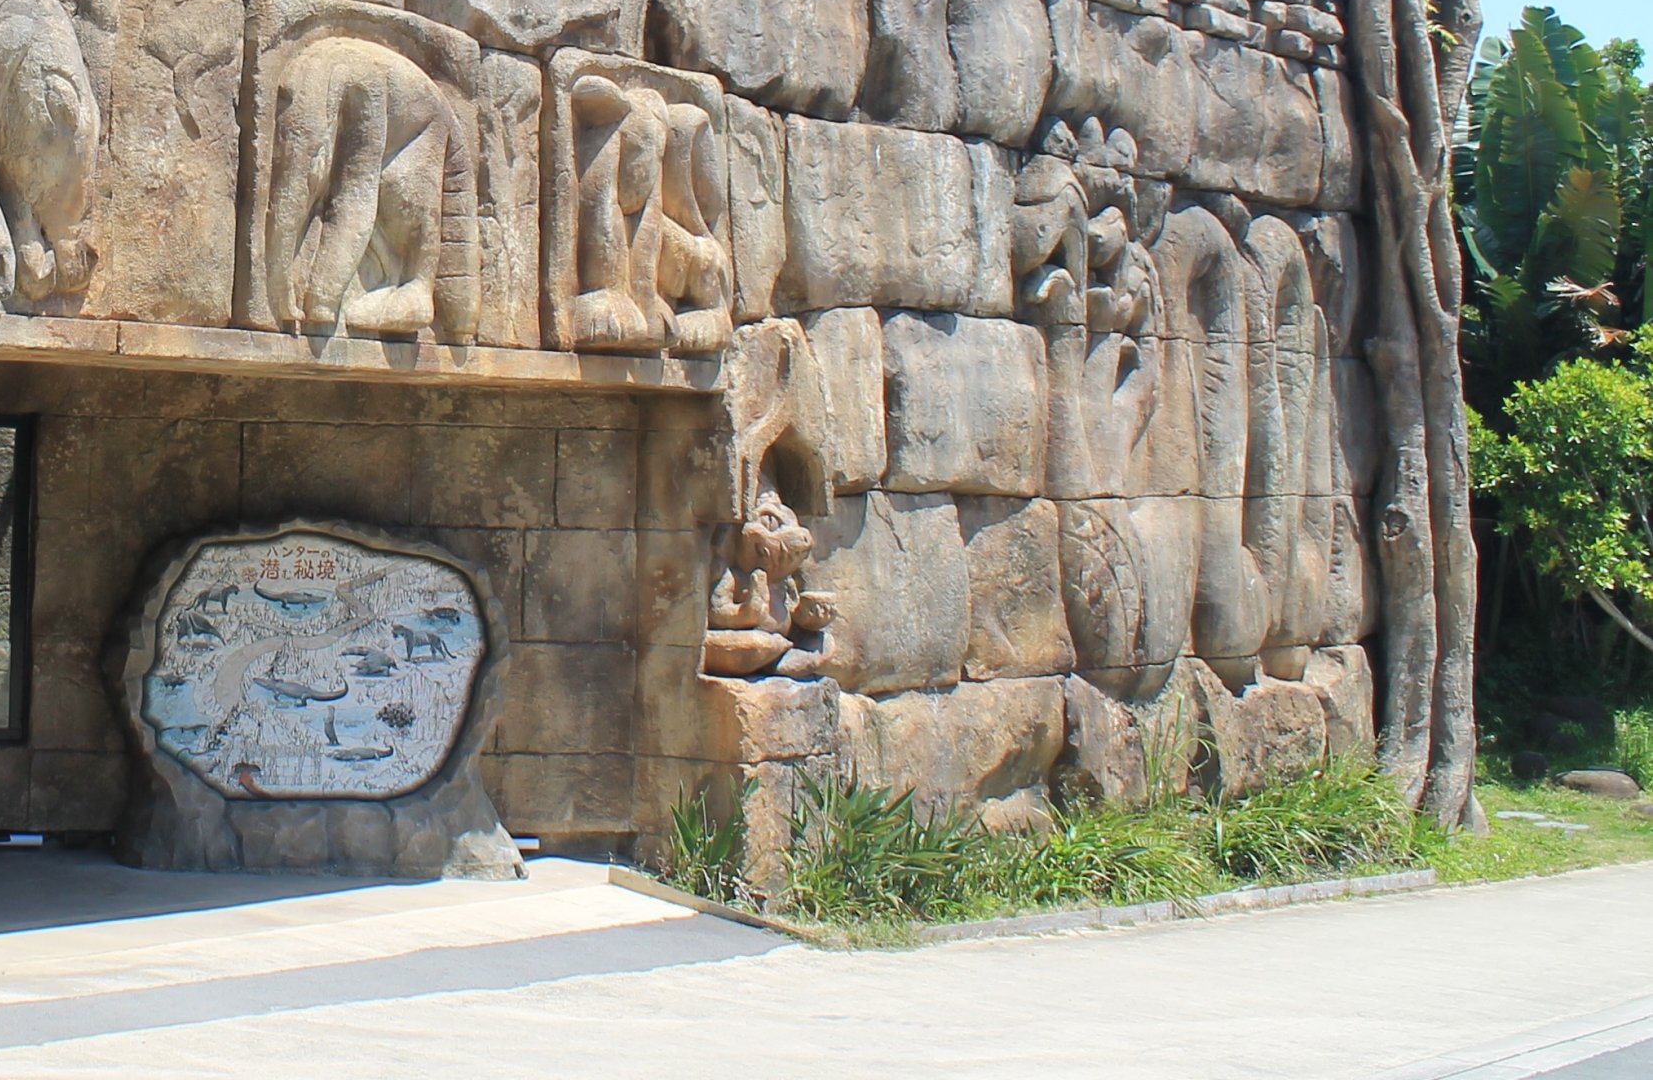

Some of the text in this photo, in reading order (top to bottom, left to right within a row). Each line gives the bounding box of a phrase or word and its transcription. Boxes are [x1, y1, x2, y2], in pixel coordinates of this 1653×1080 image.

[267, 546, 330, 558] ハンターの
[260, 559, 336, 580] 潜む秘境
